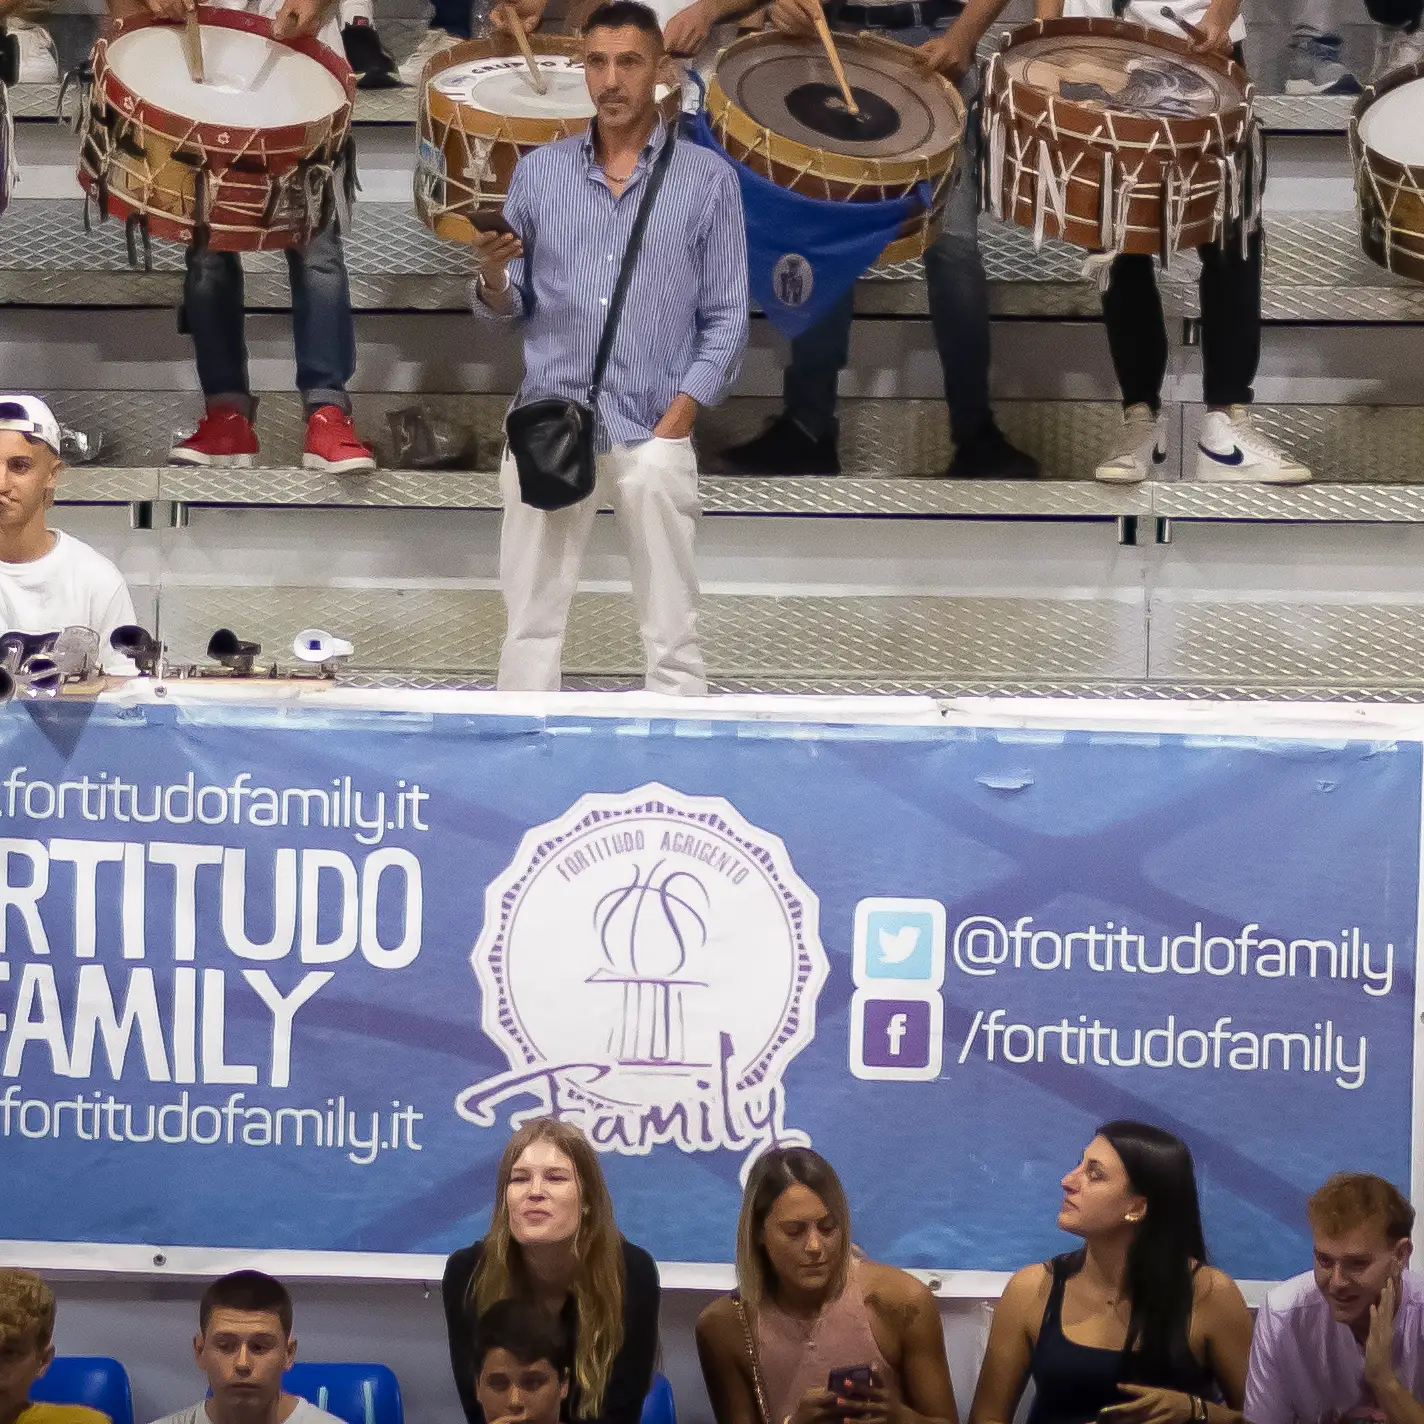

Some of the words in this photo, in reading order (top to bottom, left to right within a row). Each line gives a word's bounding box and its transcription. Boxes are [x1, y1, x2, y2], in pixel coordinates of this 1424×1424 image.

[556, 828, 645, 882] FORTITUDO
[659, 830, 751, 886] AGRIGENTO
[952, 914, 1396, 997] @fortitudofamily
[958, 1008, 1368, 1090] /fortitudofamily
